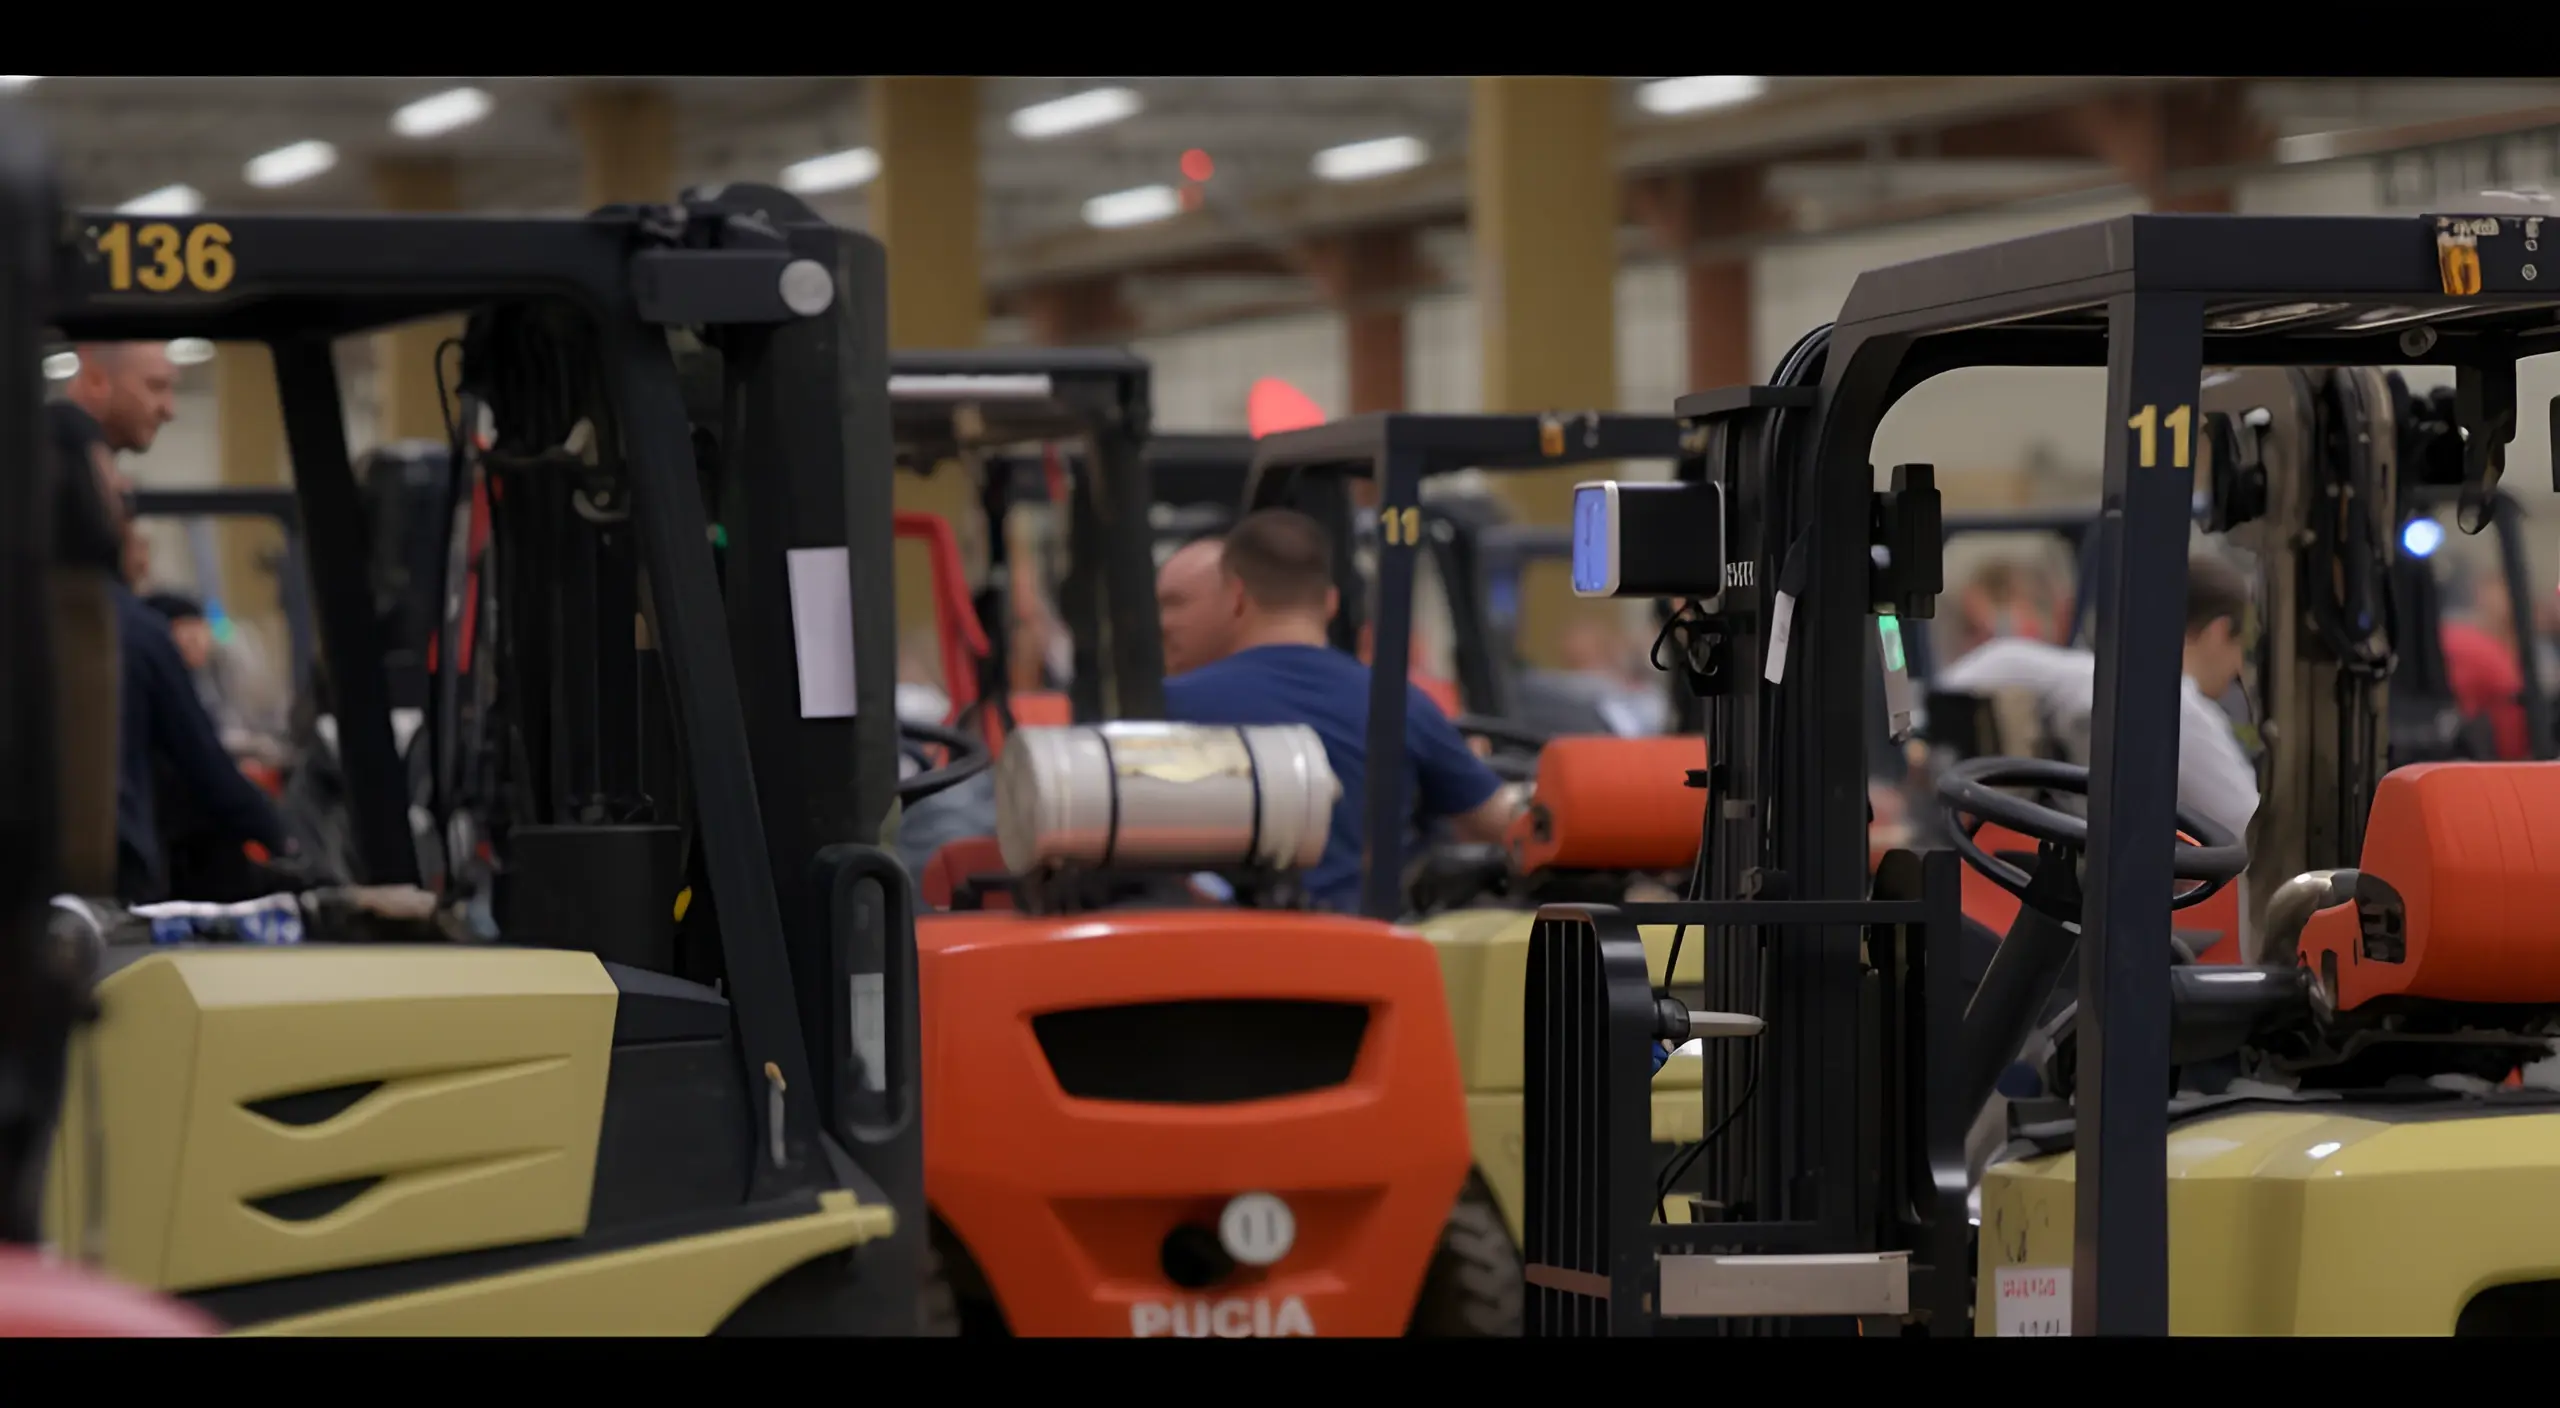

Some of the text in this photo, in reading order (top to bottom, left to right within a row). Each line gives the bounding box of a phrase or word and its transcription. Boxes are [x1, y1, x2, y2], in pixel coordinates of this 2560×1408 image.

[97, 221, 235, 292] 136
[2127, 404, 2191, 468] 11
[1381, 506, 1420, 545] 11
